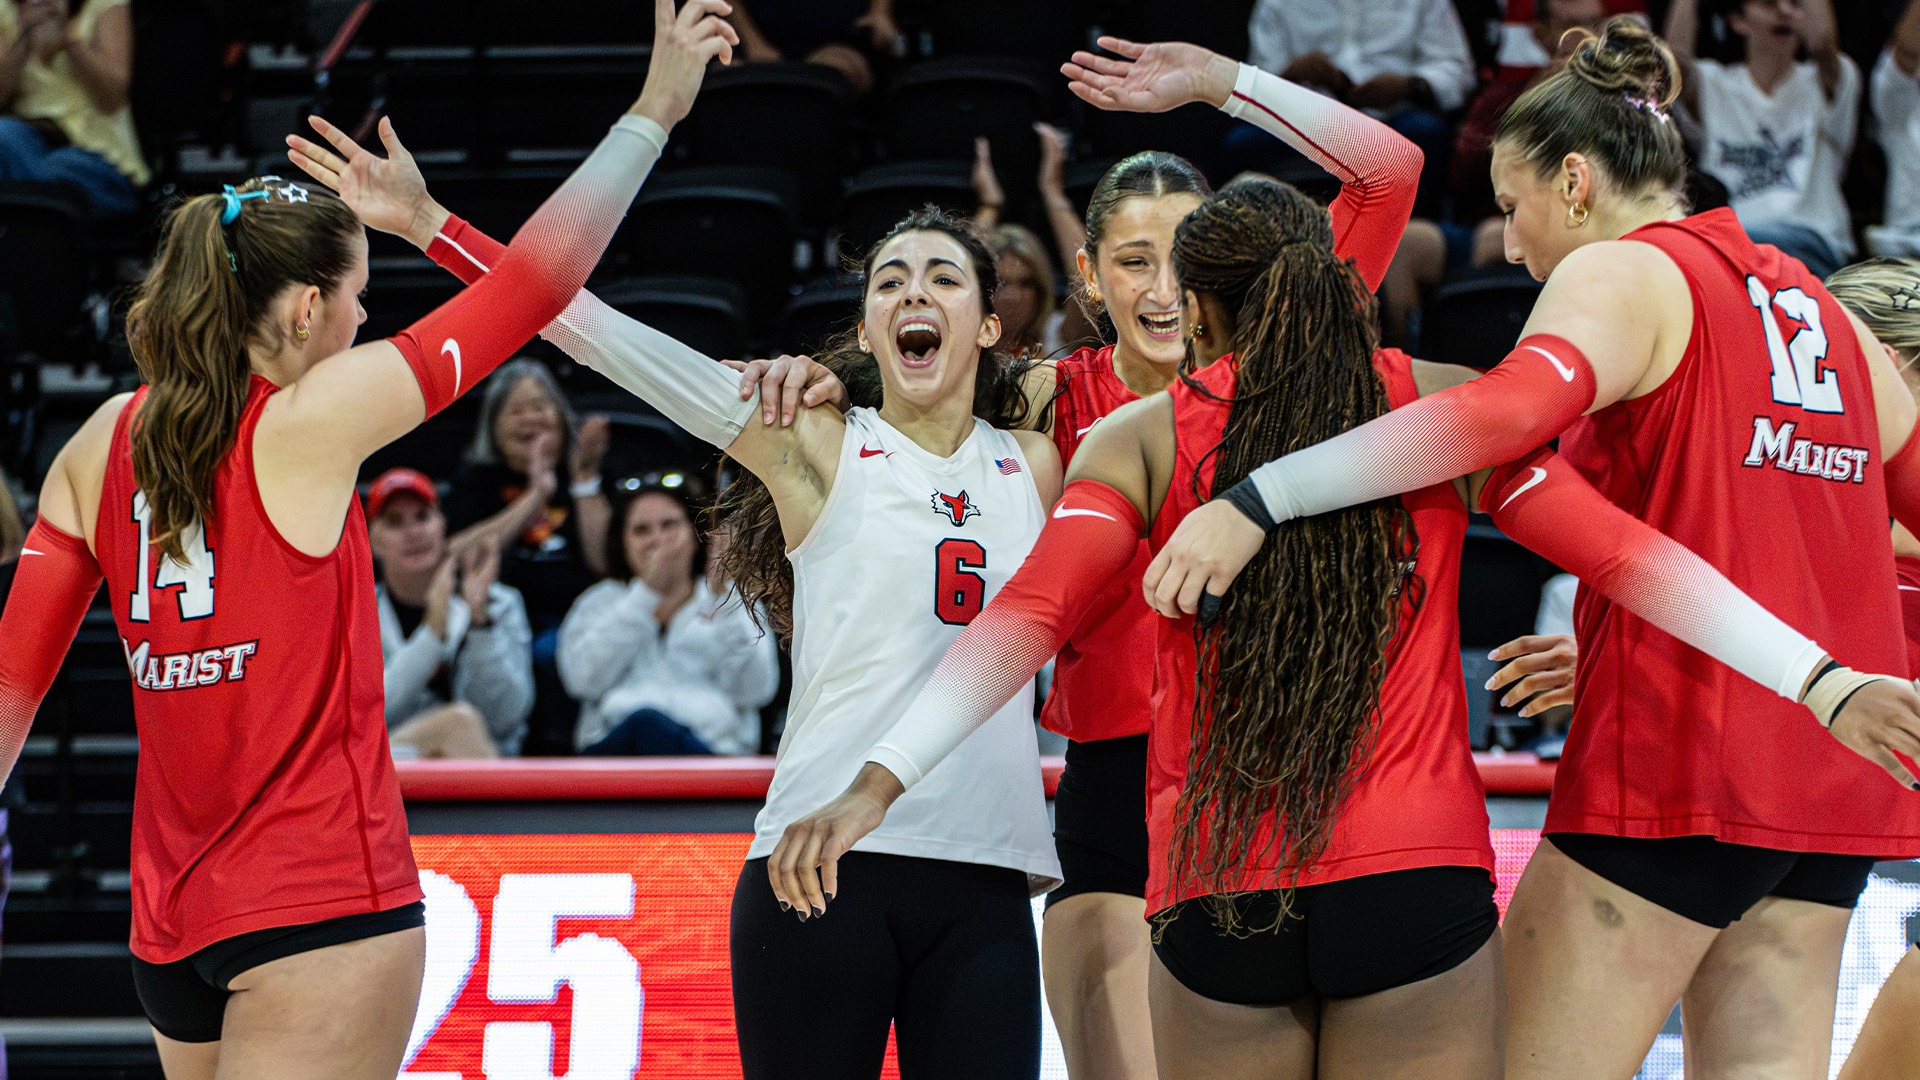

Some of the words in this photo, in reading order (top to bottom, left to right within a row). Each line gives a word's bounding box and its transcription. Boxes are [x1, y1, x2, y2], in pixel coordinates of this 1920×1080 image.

[1746, 274, 1844, 414] 12
[1742, 415, 1869, 484] MARIST
[129, 488, 215, 622] 14
[934, 537, 986, 626] 6
[122, 636, 260, 692] MARIST
